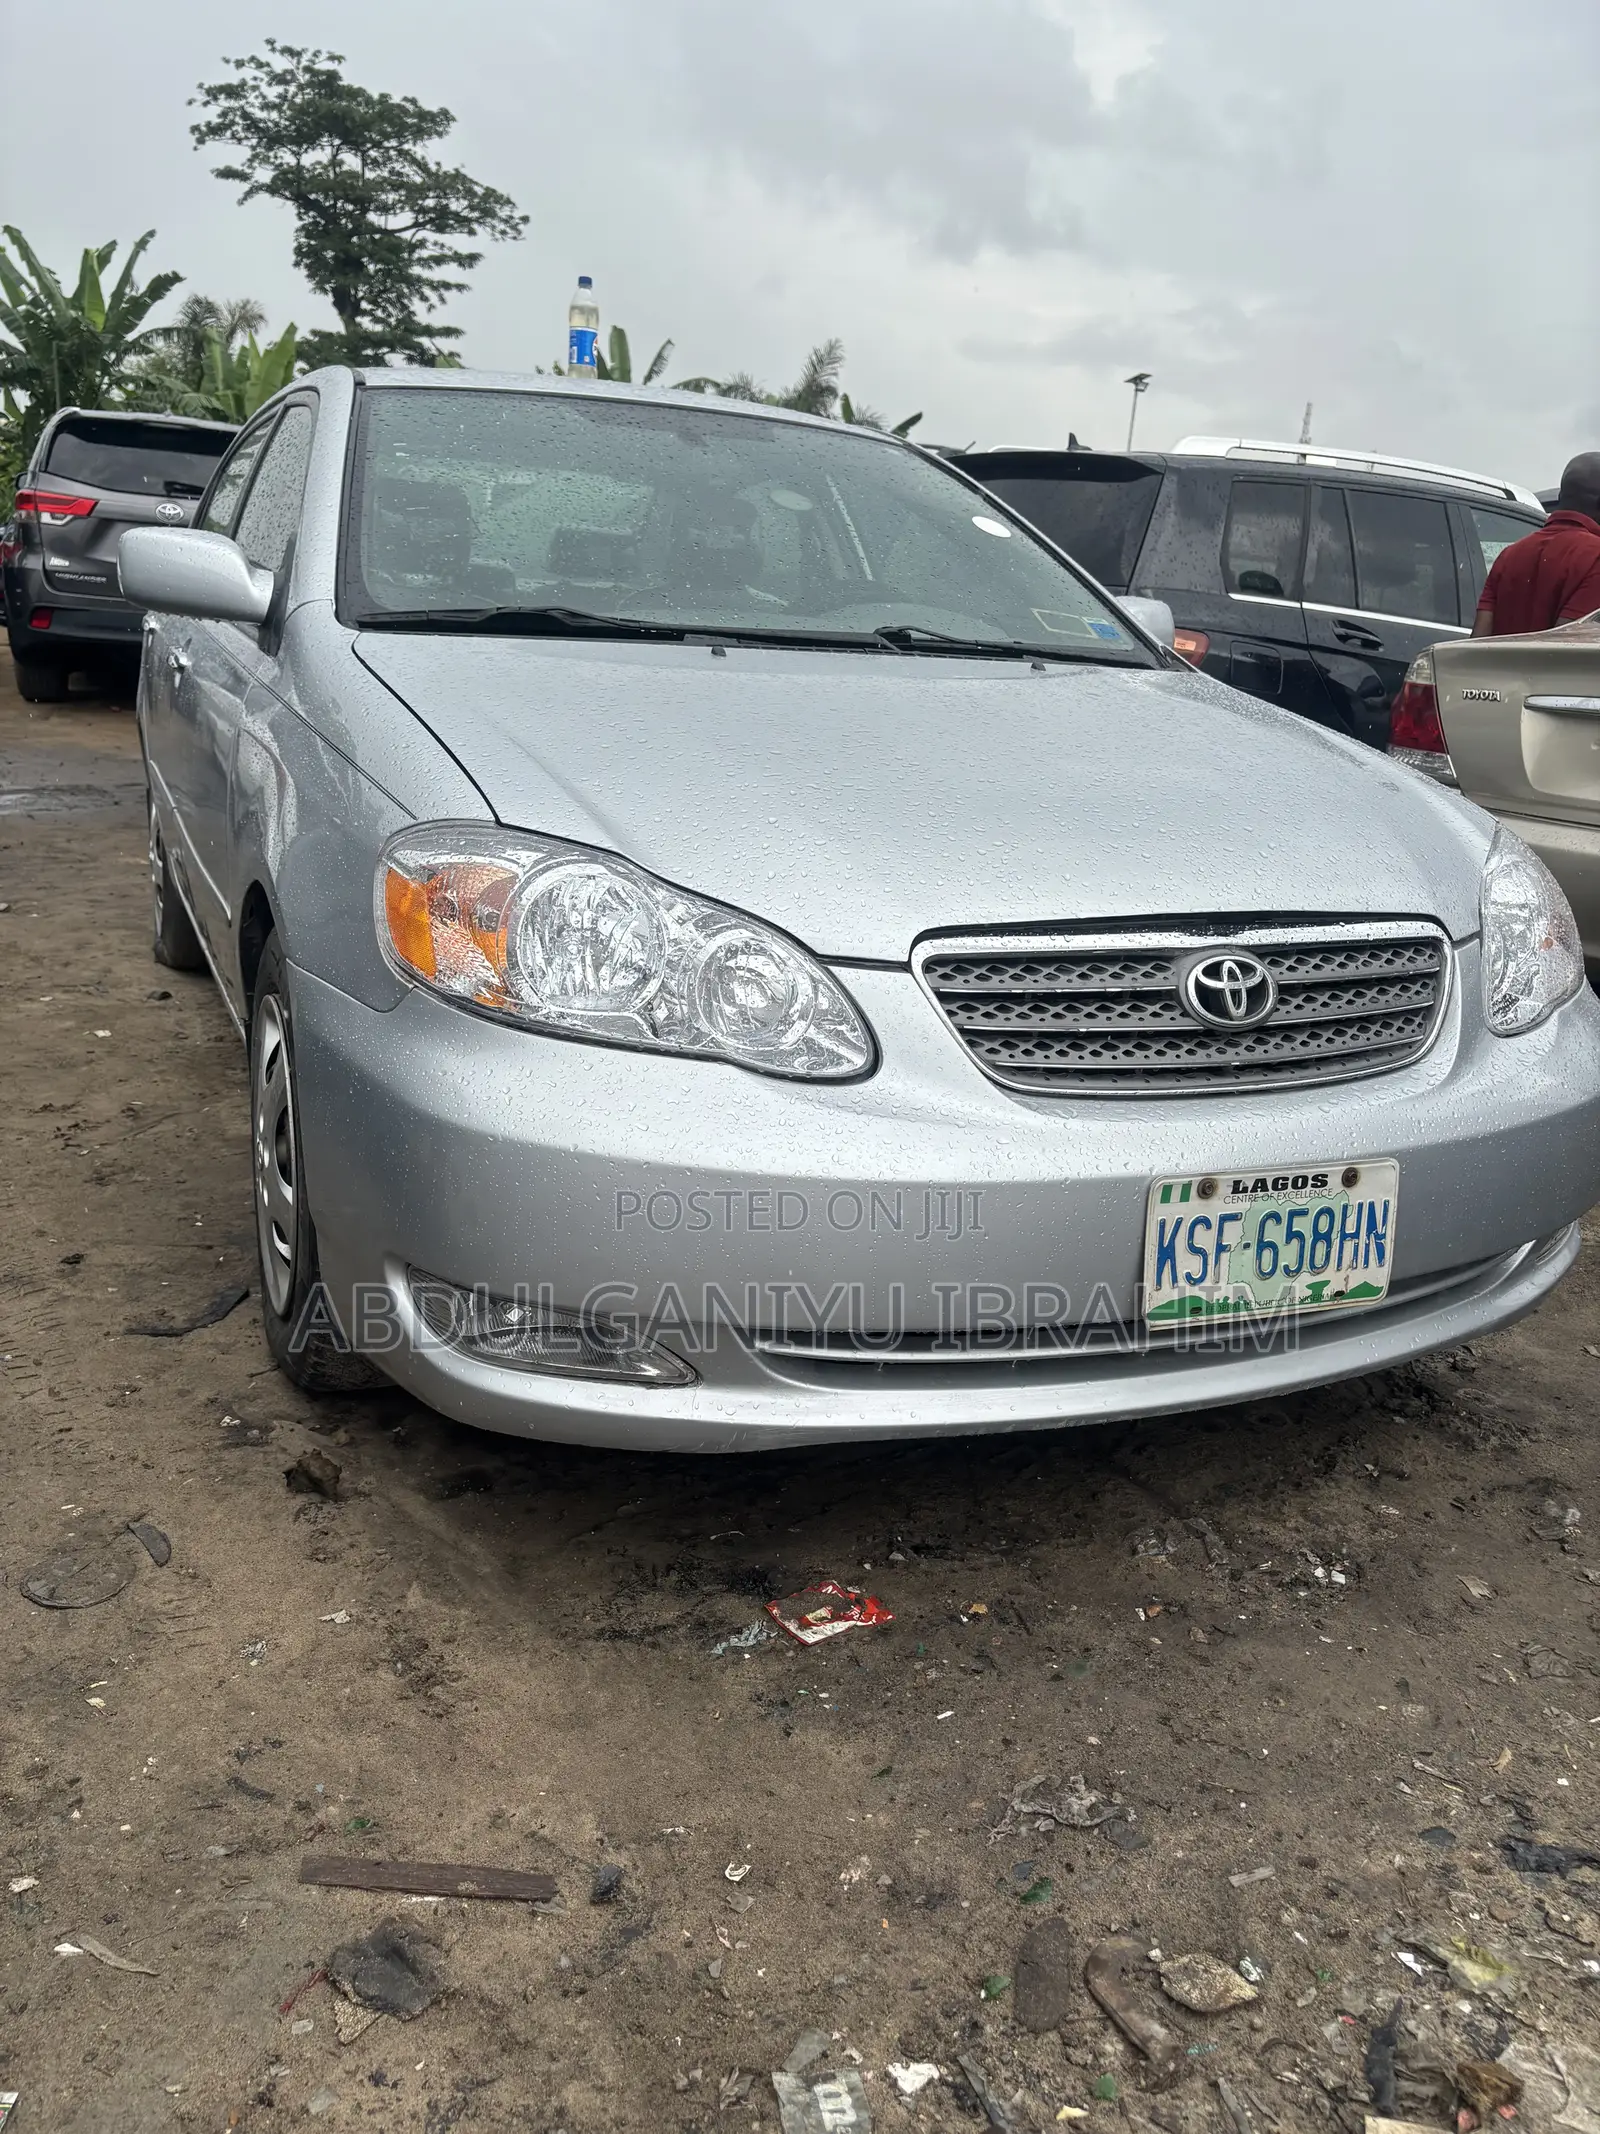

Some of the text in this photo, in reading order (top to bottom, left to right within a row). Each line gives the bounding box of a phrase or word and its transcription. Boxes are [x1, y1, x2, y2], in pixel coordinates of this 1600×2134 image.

[1462, 688, 1500, 702] TOYOTA
[1231, 1173, 1329, 1195] LAGOS
[1223, 1188, 1333, 1204] CENTRE OF EXCELLENCE
[1154, 1199, 1390, 1291] KSF-658HN
